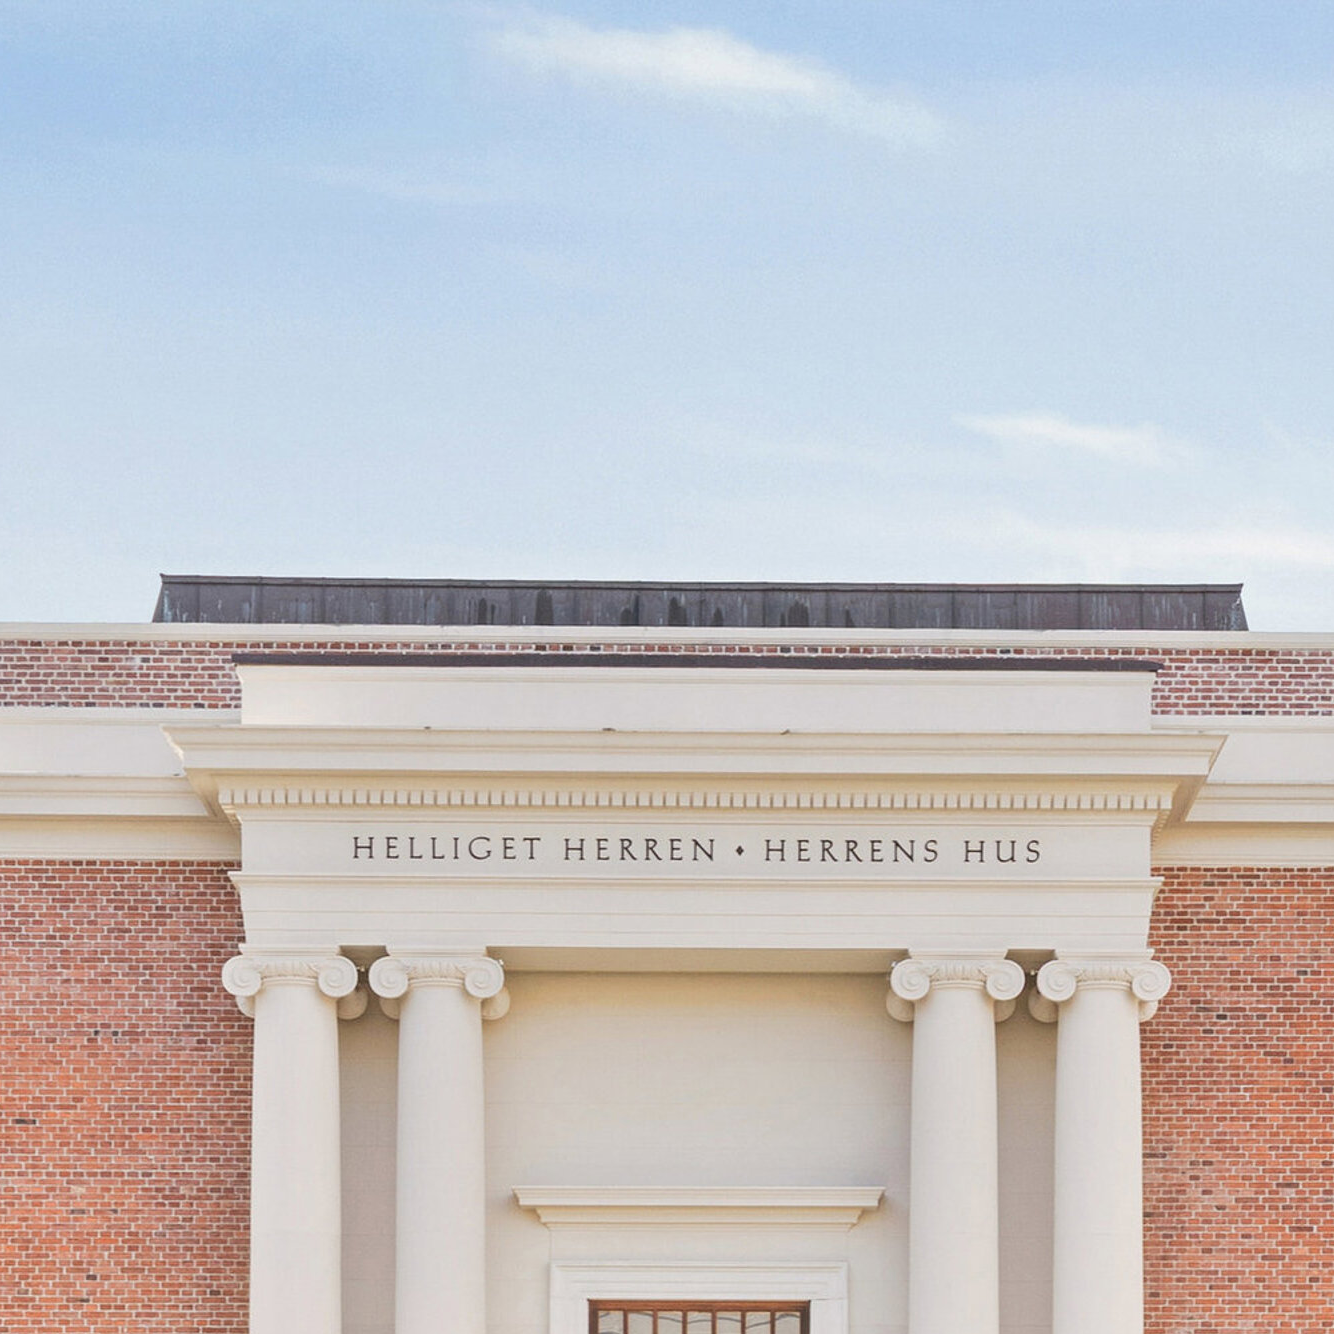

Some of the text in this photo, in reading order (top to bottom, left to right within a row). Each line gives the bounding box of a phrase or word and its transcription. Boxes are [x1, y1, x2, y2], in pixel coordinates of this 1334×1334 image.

[353, 836, 1041, 863] HELLIGET HERREN HERRENS HUS
